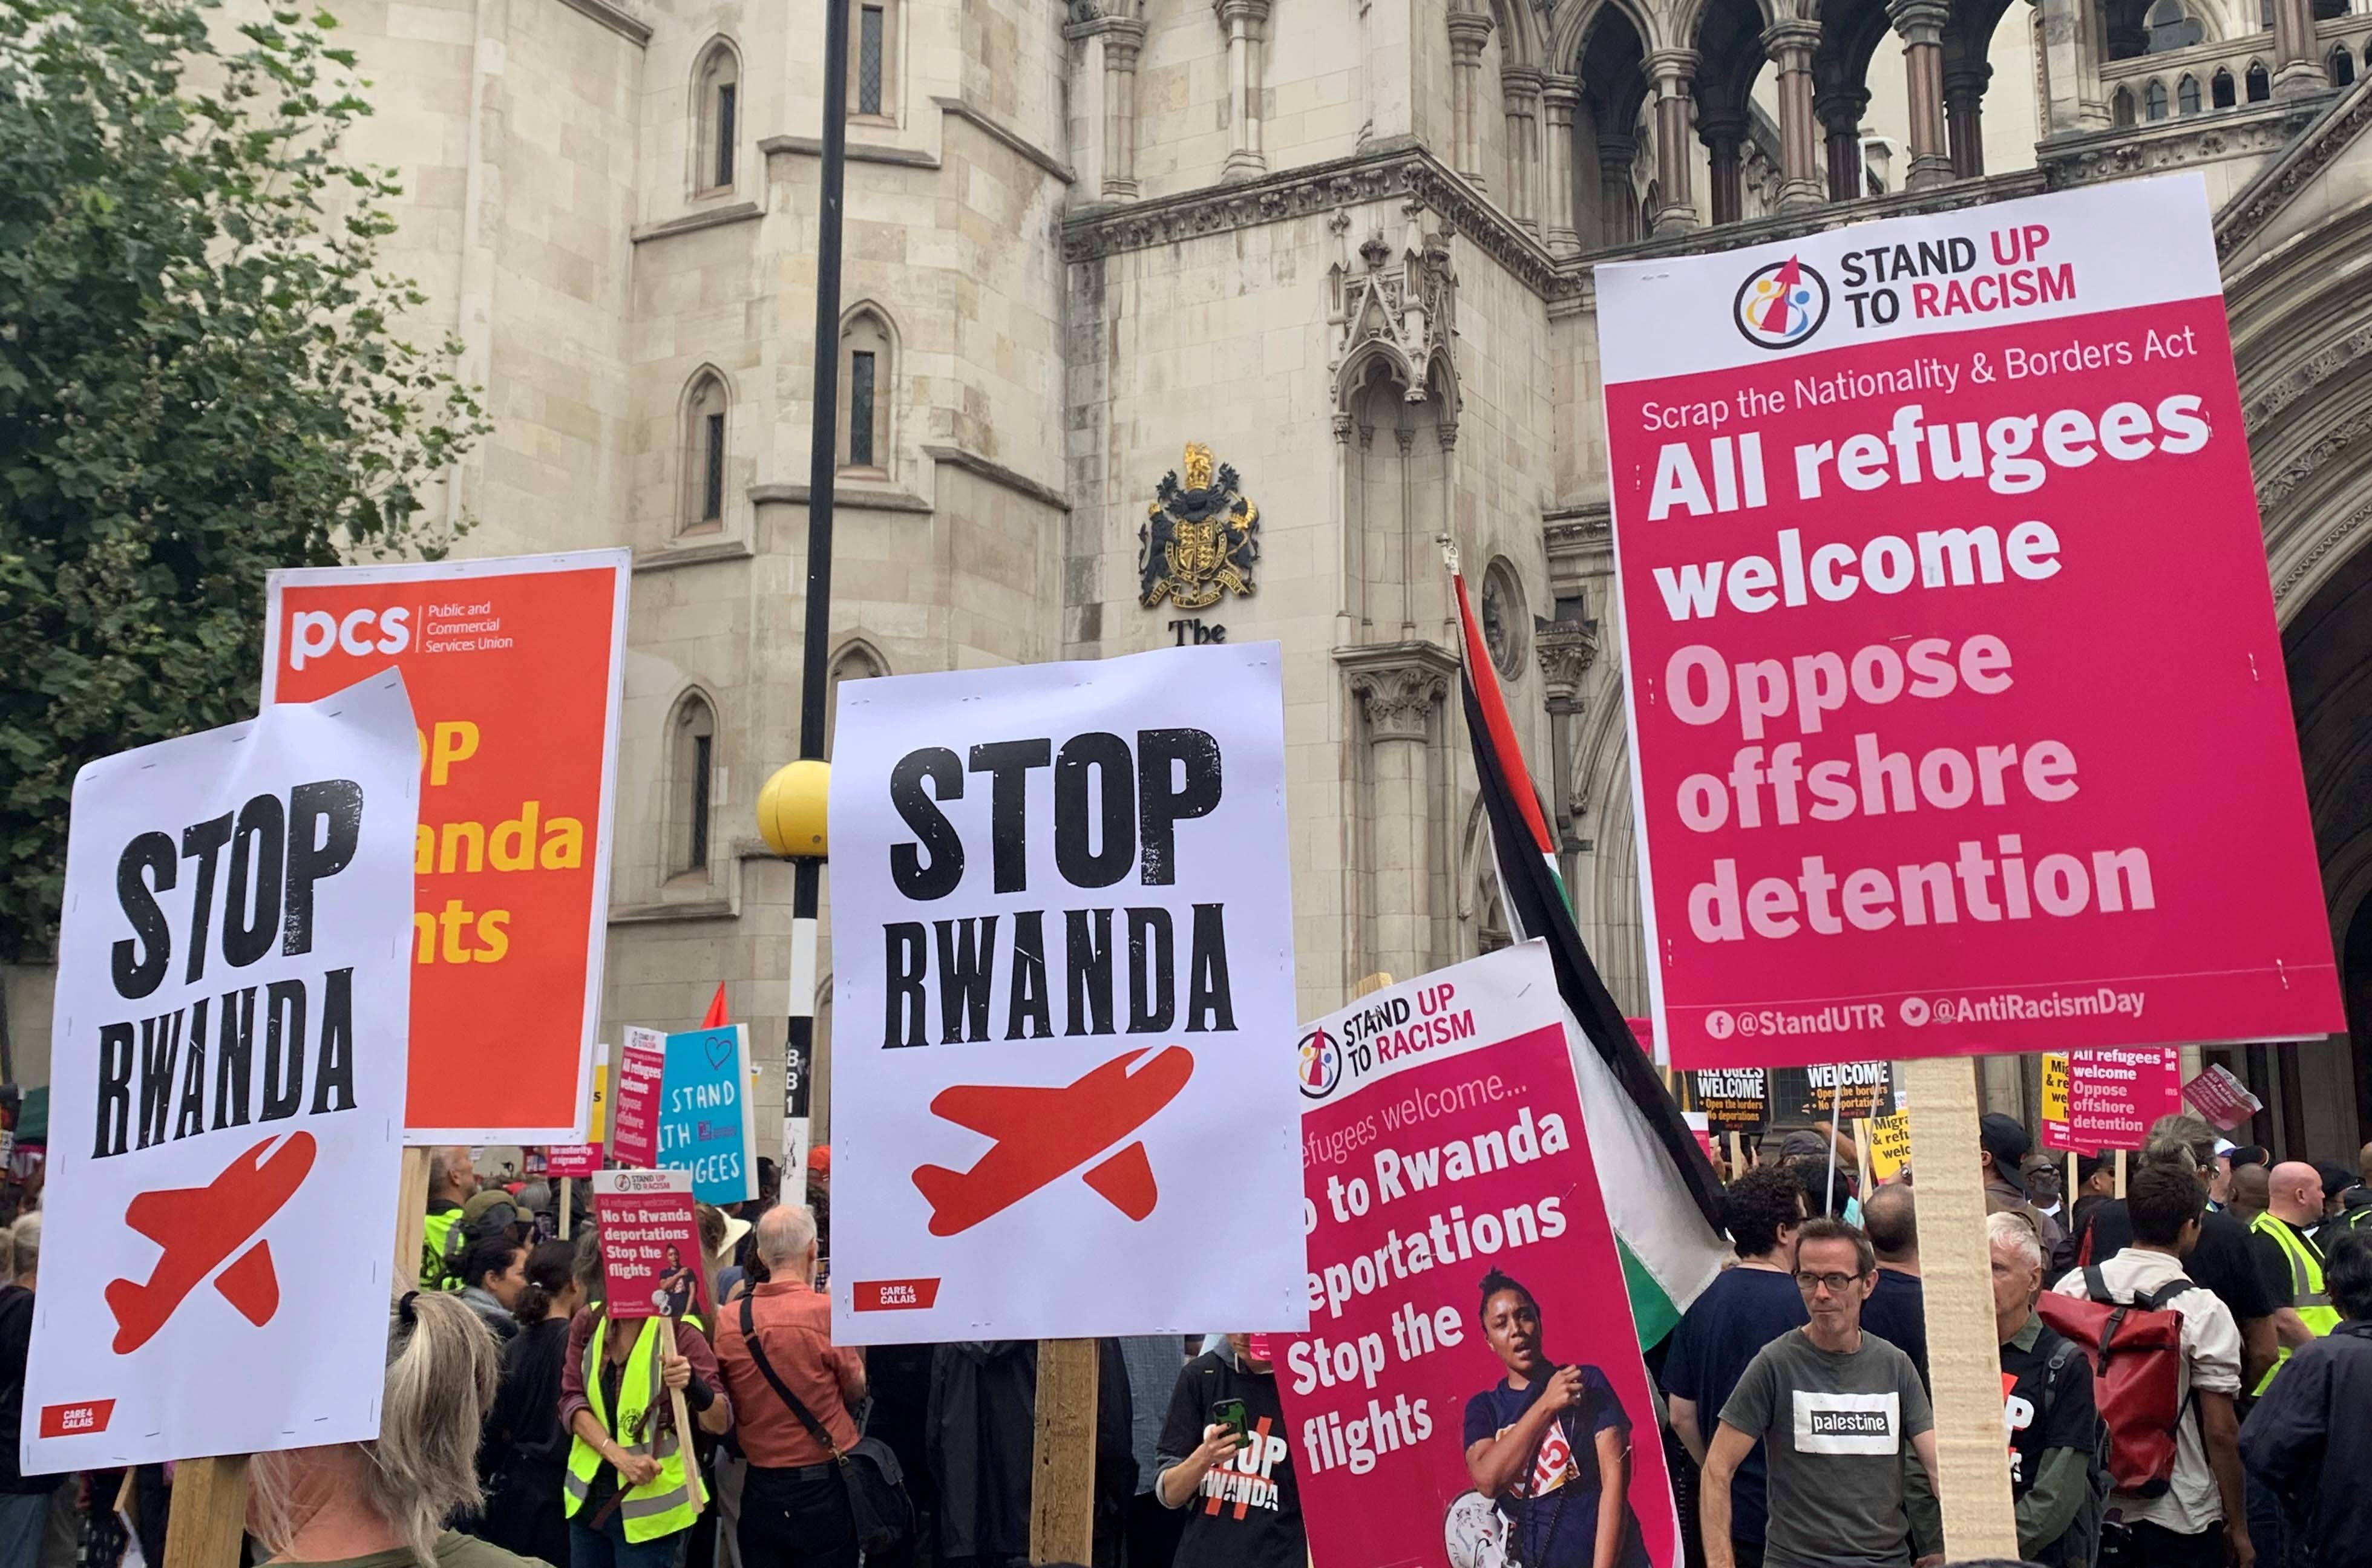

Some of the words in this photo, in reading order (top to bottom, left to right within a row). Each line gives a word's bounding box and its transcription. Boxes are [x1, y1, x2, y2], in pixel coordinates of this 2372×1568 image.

[1840, 238, 1976, 288] STAND
[1990, 224, 2051, 266] UP
[1845, 291, 1899, 328] TO
[1913, 263, 2076, 318] RACISM
[1642, 398, 1729, 432] Scrap
[1736, 387, 1784, 418] the
[1796, 358, 1959, 408] Nationality
[1971, 353, 1997, 383] &
[2006, 340, 2130, 380] Borders
[2143, 324, 2198, 362] Act
[1648, 431, 1768, 521] All
[1794, 394, 2210, 494] refugees
[1653, 520, 2062, 621] welcome
[427, 604, 464, 617] Public
[467, 601, 491, 615] and
[427, 619, 500, 636] Commercial
[1168, 618, 1226, 647] The
[290, 607, 409, 671] pcs
[425, 639, 476, 653] Services
[477, 636, 513, 650] Union
[1665, 634, 2013, 741] Oppose
[1676, 733, 2079, 832] offshore
[890, 728, 1222, 901] STOP
[111, 779, 363, 999] STOP
[1688, 834, 2155, 943] detention
[881, 903, 1239, 1049] RWANDA
[1343, 997, 1410, 1047] STAND
[1418, 982, 1455, 1016] UP
[1737, 1003, 1885, 1037] @StandUTR
[1935, 987, 2146, 1023] @AntiRacismDay
[1348, 1044, 1372, 1077] TO
[1375, 1009, 1476, 1064] RACISM
[91, 967, 358, 1160] RWANDA
[2073, 1050, 2093, 1061] All
[2097, 1048, 2161, 1066] refugees
[2046, 1074, 2054, 1086] &
[2073, 1065, 2137, 1080] welcome
[672, 1080, 735, 1113] STAND
[1697, 1077, 1764, 1099] WELCOME
[1856, 1086, 1888, 1096] bordrs
[2074, 1081, 2128, 1098] Oppose
[1381, 1074, 1527, 1132] welcome...
[1706, 1099, 1723, 1110] Open
[1725, 1099, 1736, 1108] the
[1737, 1099, 1763, 1109] borders
[1818, 1100, 1829, 1110] No
[2074, 1099, 2135, 1114] offshore
[2074, 1114, 2143, 1132] detention
[1873, 1134, 1882, 1145] &
[1327, 1175, 1370, 1223] to
[1374, 1106, 1570, 1205] Rwanda
[601, 1210, 620, 1223] No
[622, 1210, 636, 1222] to
[638, 1209, 692, 1223] Rwanda
[604, 1227, 689, 1243] deportations
[606, 1246, 638, 1261] Stop
[640, 1246, 661, 1258] the
[609, 1264, 651, 1279] flights
[880, 1286, 906, 1296] CARE
[880, 1295, 916, 1304] CALAIS
[1288, 1331, 1385, 1396] Stop
[1392, 1302, 1464, 1363] the
[62, 1417, 93, 1429] CALAIS
[64, 1410, 87, 1420] CARE
[1813, 1413, 1886, 1432] palestine
[1303, 1393, 1432, 1475] flights
